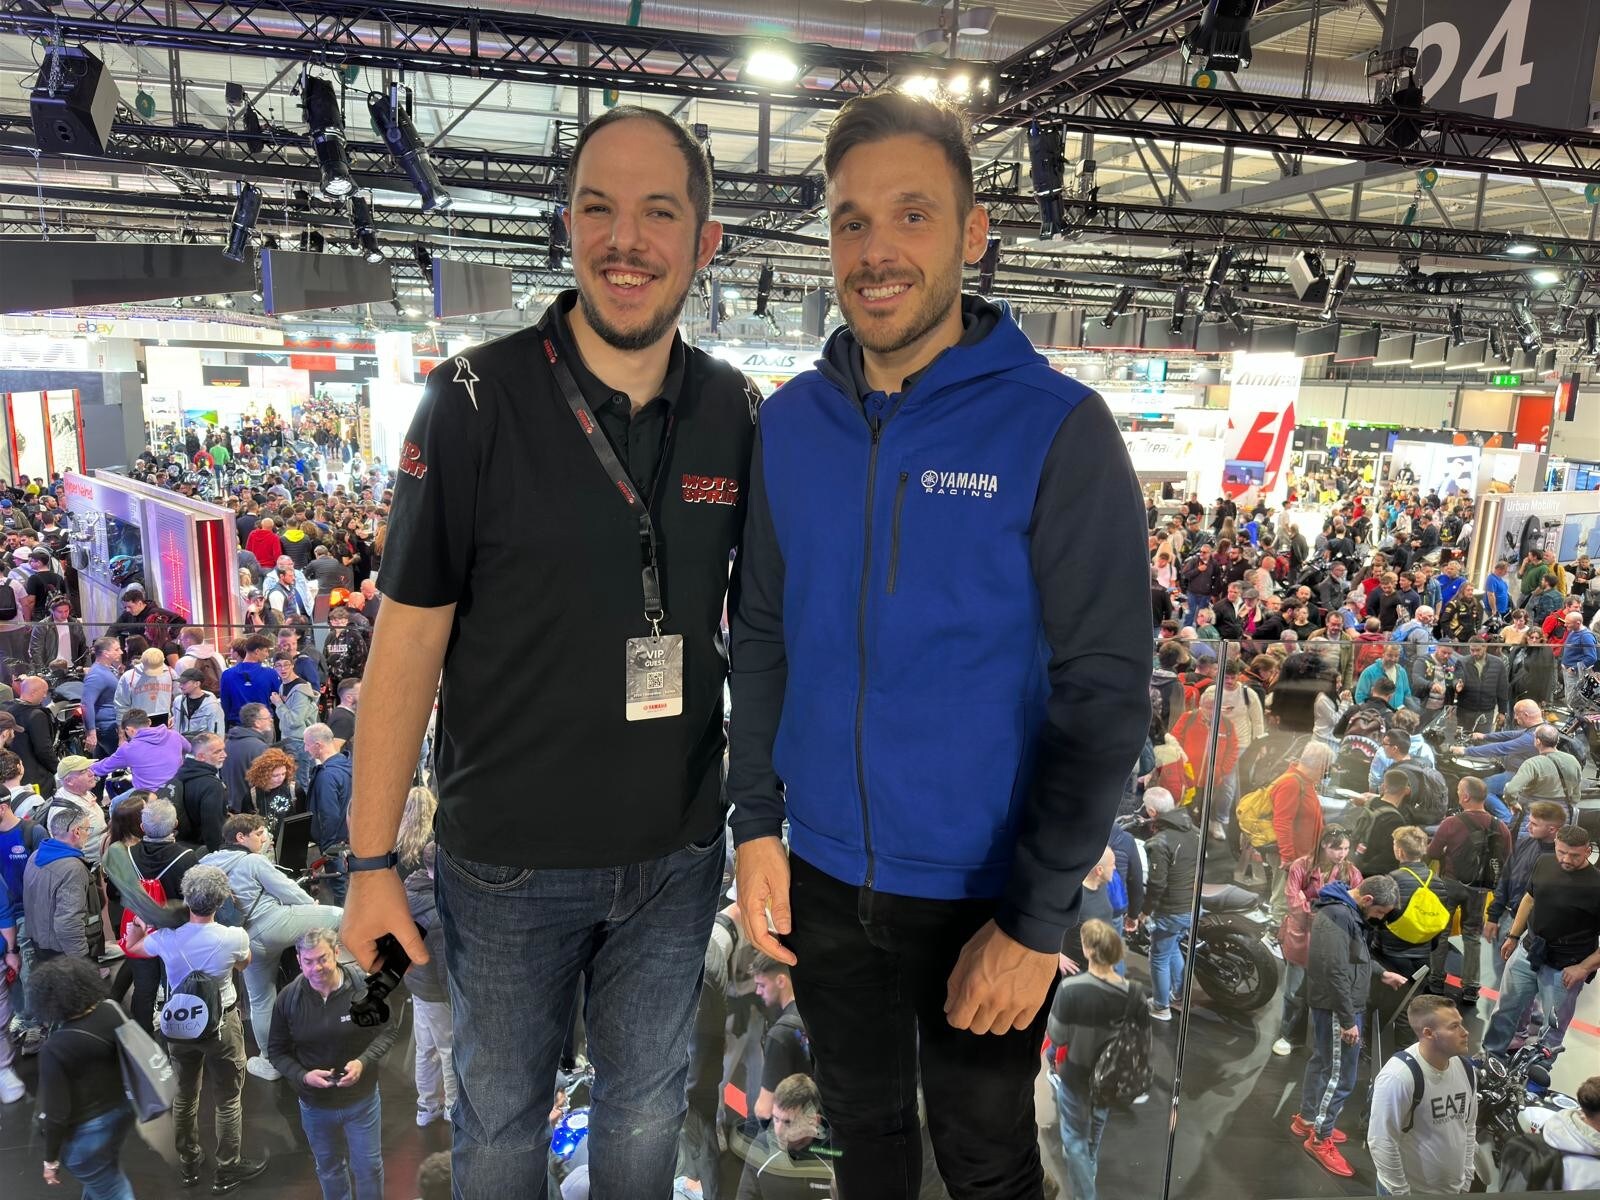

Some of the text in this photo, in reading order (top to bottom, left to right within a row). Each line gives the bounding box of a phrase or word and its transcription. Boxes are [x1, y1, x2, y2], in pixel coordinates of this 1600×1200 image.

[77, 320, 115, 335] ebay
[743, 354, 797, 368] AXXIS
[682, 473, 739, 492] MOTO
[940, 472, 998, 492] YAMAHA
[925, 488, 993, 499] RACING
[1506, 499, 1560, 512] Urban Mobility
[646, 649, 664, 659] VIP
[163, 1004, 203, 1022] OOF
[1430, 1091, 1467, 1119] EA7
